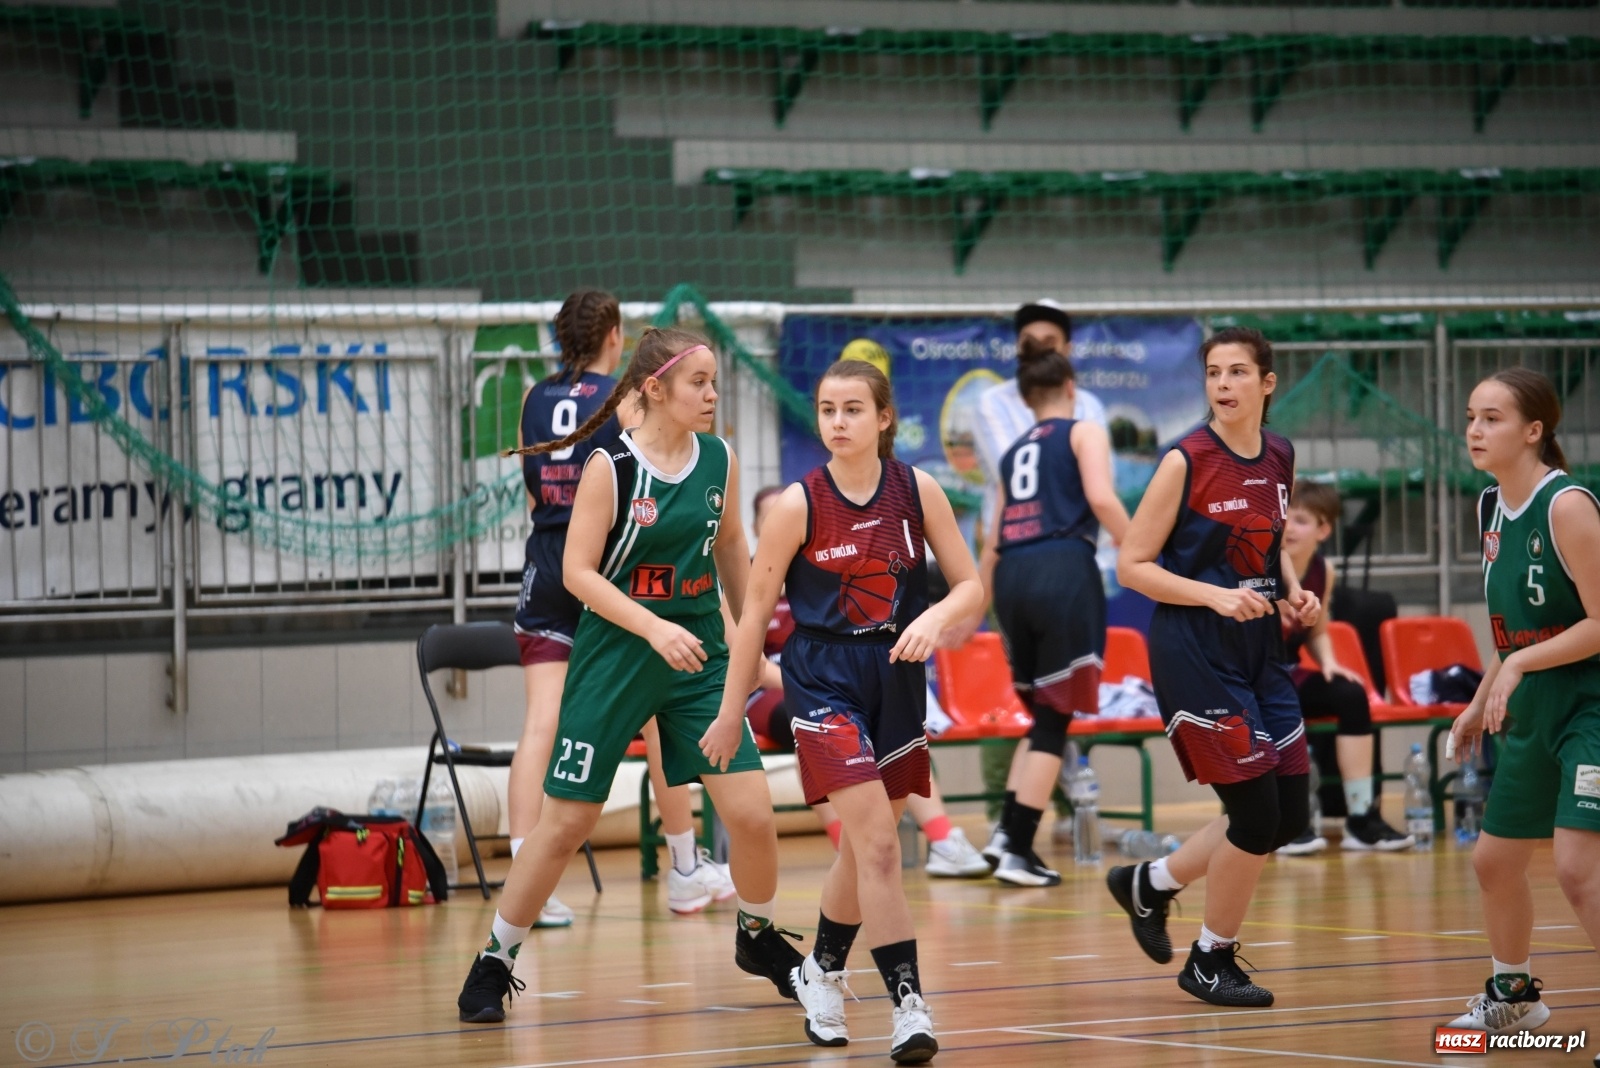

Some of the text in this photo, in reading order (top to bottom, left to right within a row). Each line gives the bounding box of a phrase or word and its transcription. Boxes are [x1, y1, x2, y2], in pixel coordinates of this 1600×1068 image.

[551, 399, 578, 460] 9
[1010, 442, 1041, 500] 8
[216, 470, 401, 533] gramy
[1208, 497, 1248, 513] UKS DWÓJKA
[815, 543, 858, 562] UKS DWÓJKA
[903, 519, 915, 558] 1
[1527, 564, 1546, 606] 5
[553, 737, 595, 783] 23
